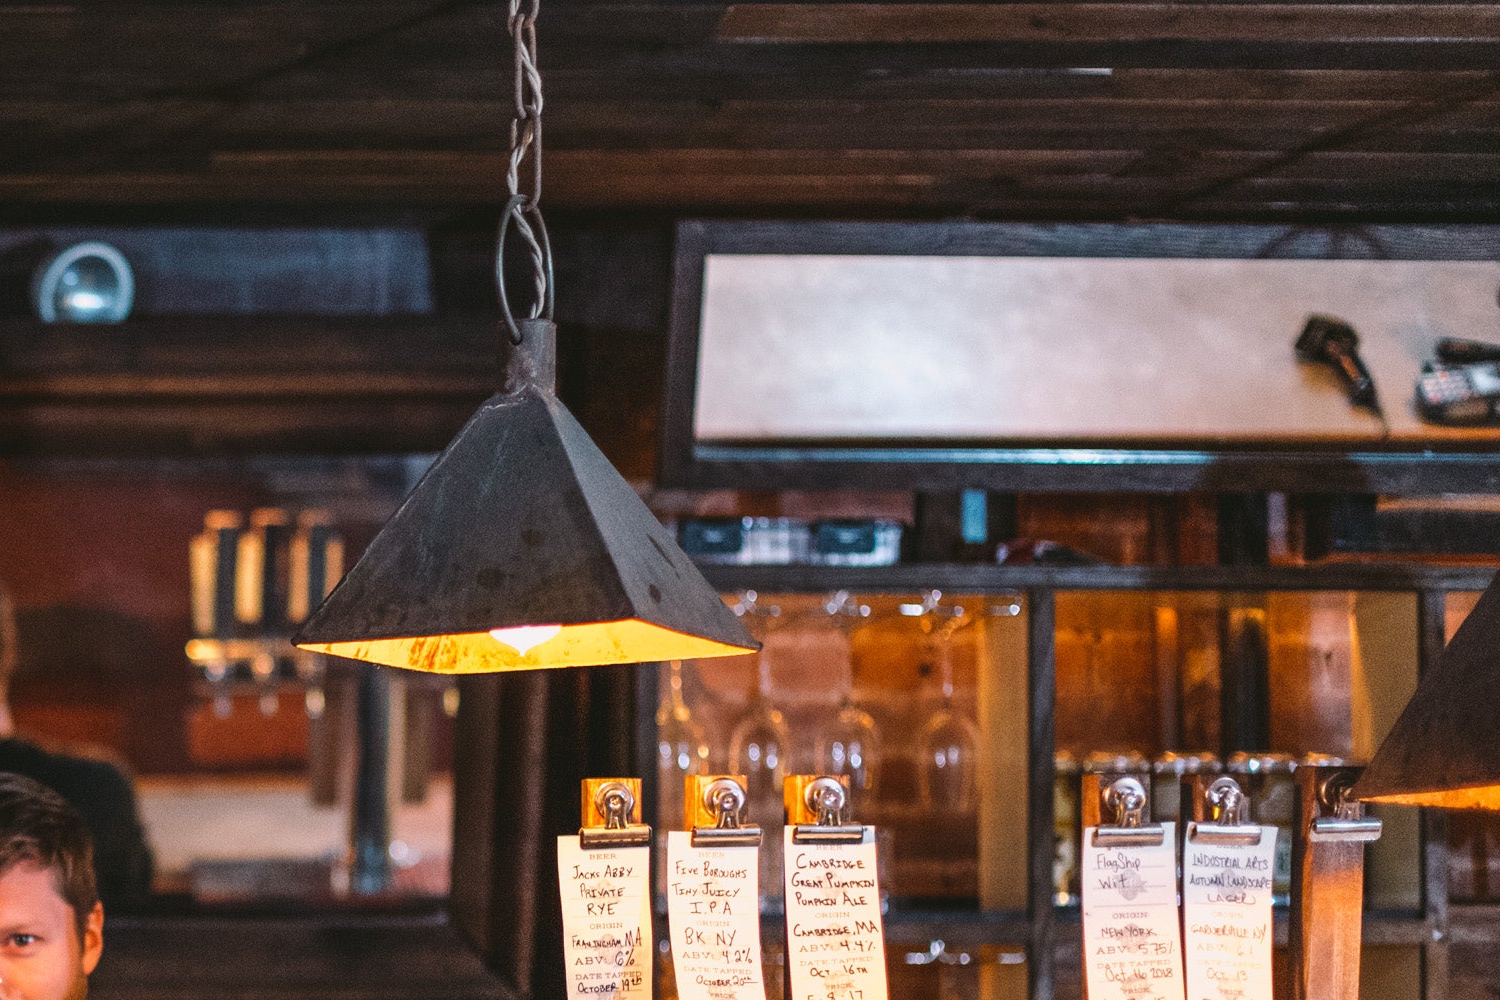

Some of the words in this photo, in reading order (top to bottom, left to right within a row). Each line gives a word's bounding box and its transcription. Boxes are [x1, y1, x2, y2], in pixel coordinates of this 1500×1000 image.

[796, 853, 865, 869] CAMBRIDGE
[1245, 857, 1268, 870] ARTS
[604, 865, 633, 878] ABBY
[703, 861, 747, 878] BOROUGHS
[792, 872, 824, 888] GREAT
[827, 873, 875, 888] PUMPKIN
[1099, 876, 1127, 889] Wit
[580, 883, 625, 898] PRIVATE
[672, 883, 697, 896] TINY
[702, 883, 740, 897] JUICY
[795, 892, 837, 907] PUMPKIN
[843, 892, 868, 907] ALE
[587, 902, 618, 915] RYE
[856, 921, 879, 934] MA
[1101, 928, 1124, 938] NEW
[1124, 927, 1157, 936] YORK
[684, 927, 706, 945] BK
[716, 930, 736, 946] NY
[614, 950, 635, 966] 6%
[605, 971, 642, 979] TAPPED
[1150, 967, 1173, 979] 2018
[696, 975, 731, 986] OCTOBER
[577, 983, 618, 993] OCTOBER
